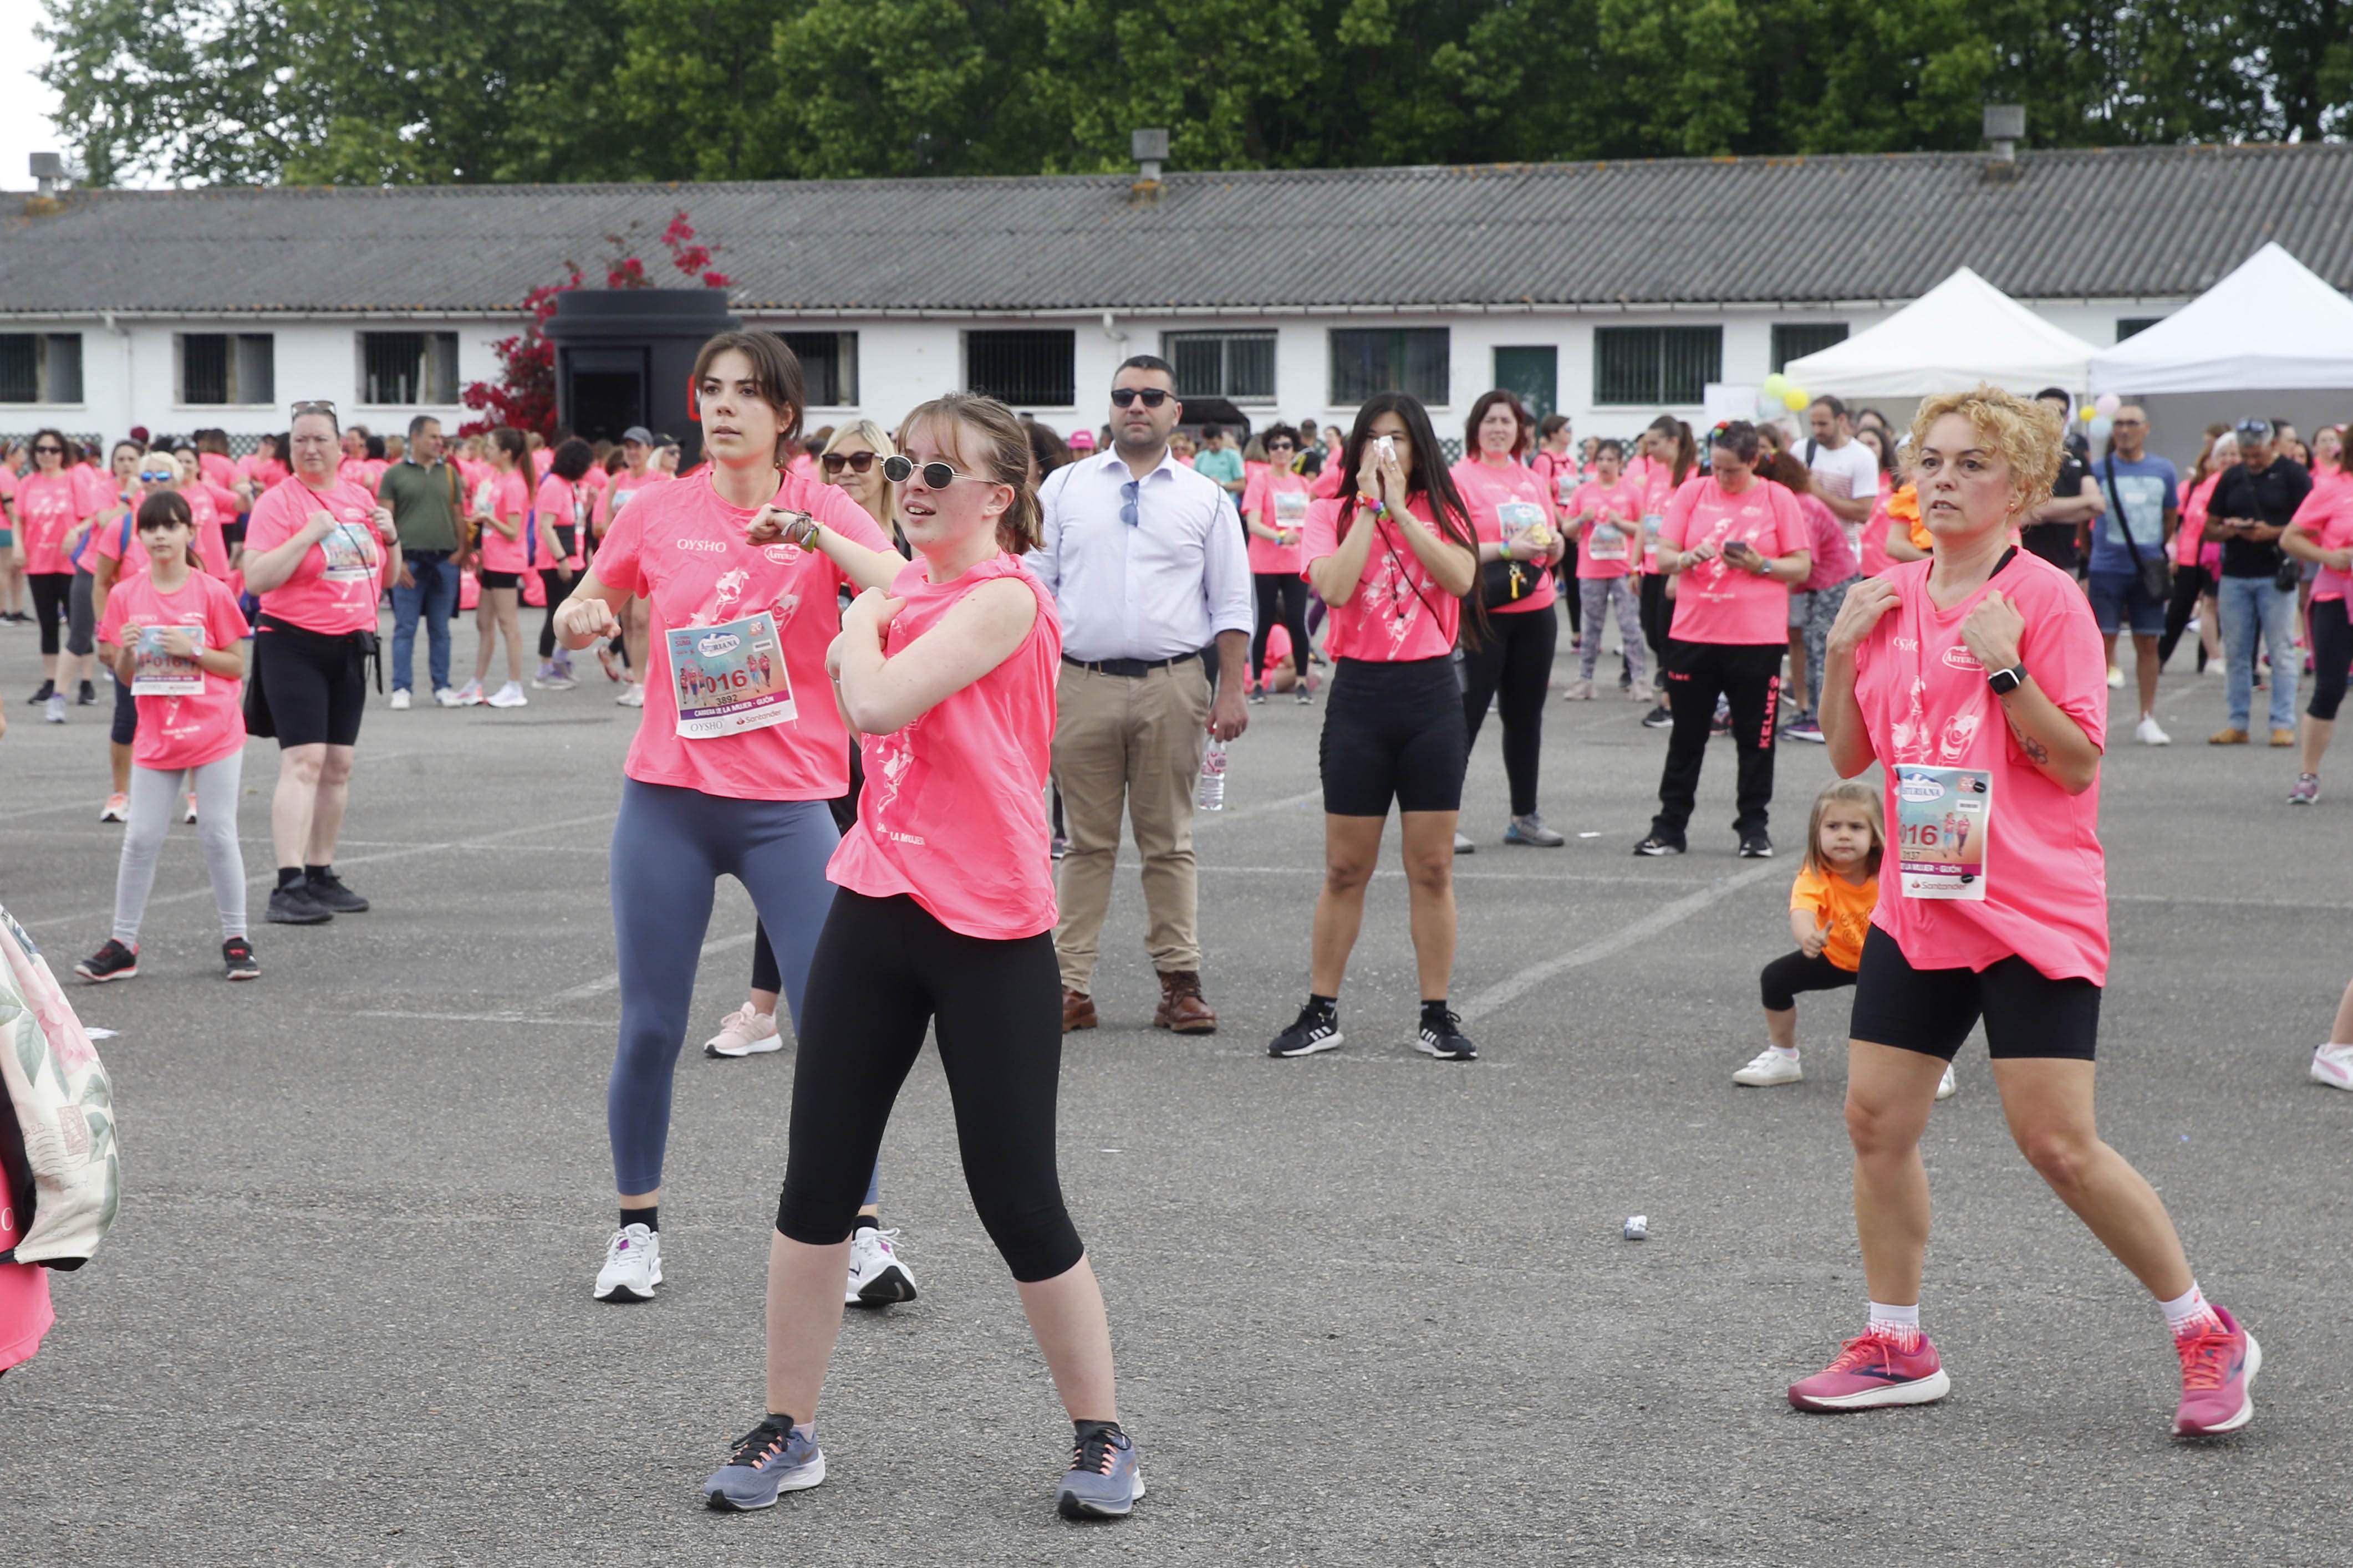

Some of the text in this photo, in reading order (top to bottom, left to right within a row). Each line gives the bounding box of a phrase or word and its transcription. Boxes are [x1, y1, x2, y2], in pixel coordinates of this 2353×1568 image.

[676, 538, 727, 553] OYSHO
[706, 669, 748, 693] 016
[716, 694, 739, 706] 3892
[722, 706, 731, 714] LA
[1758, 688, 1778, 748] KELME
[690, 709, 781, 732] OYSHO Santander
